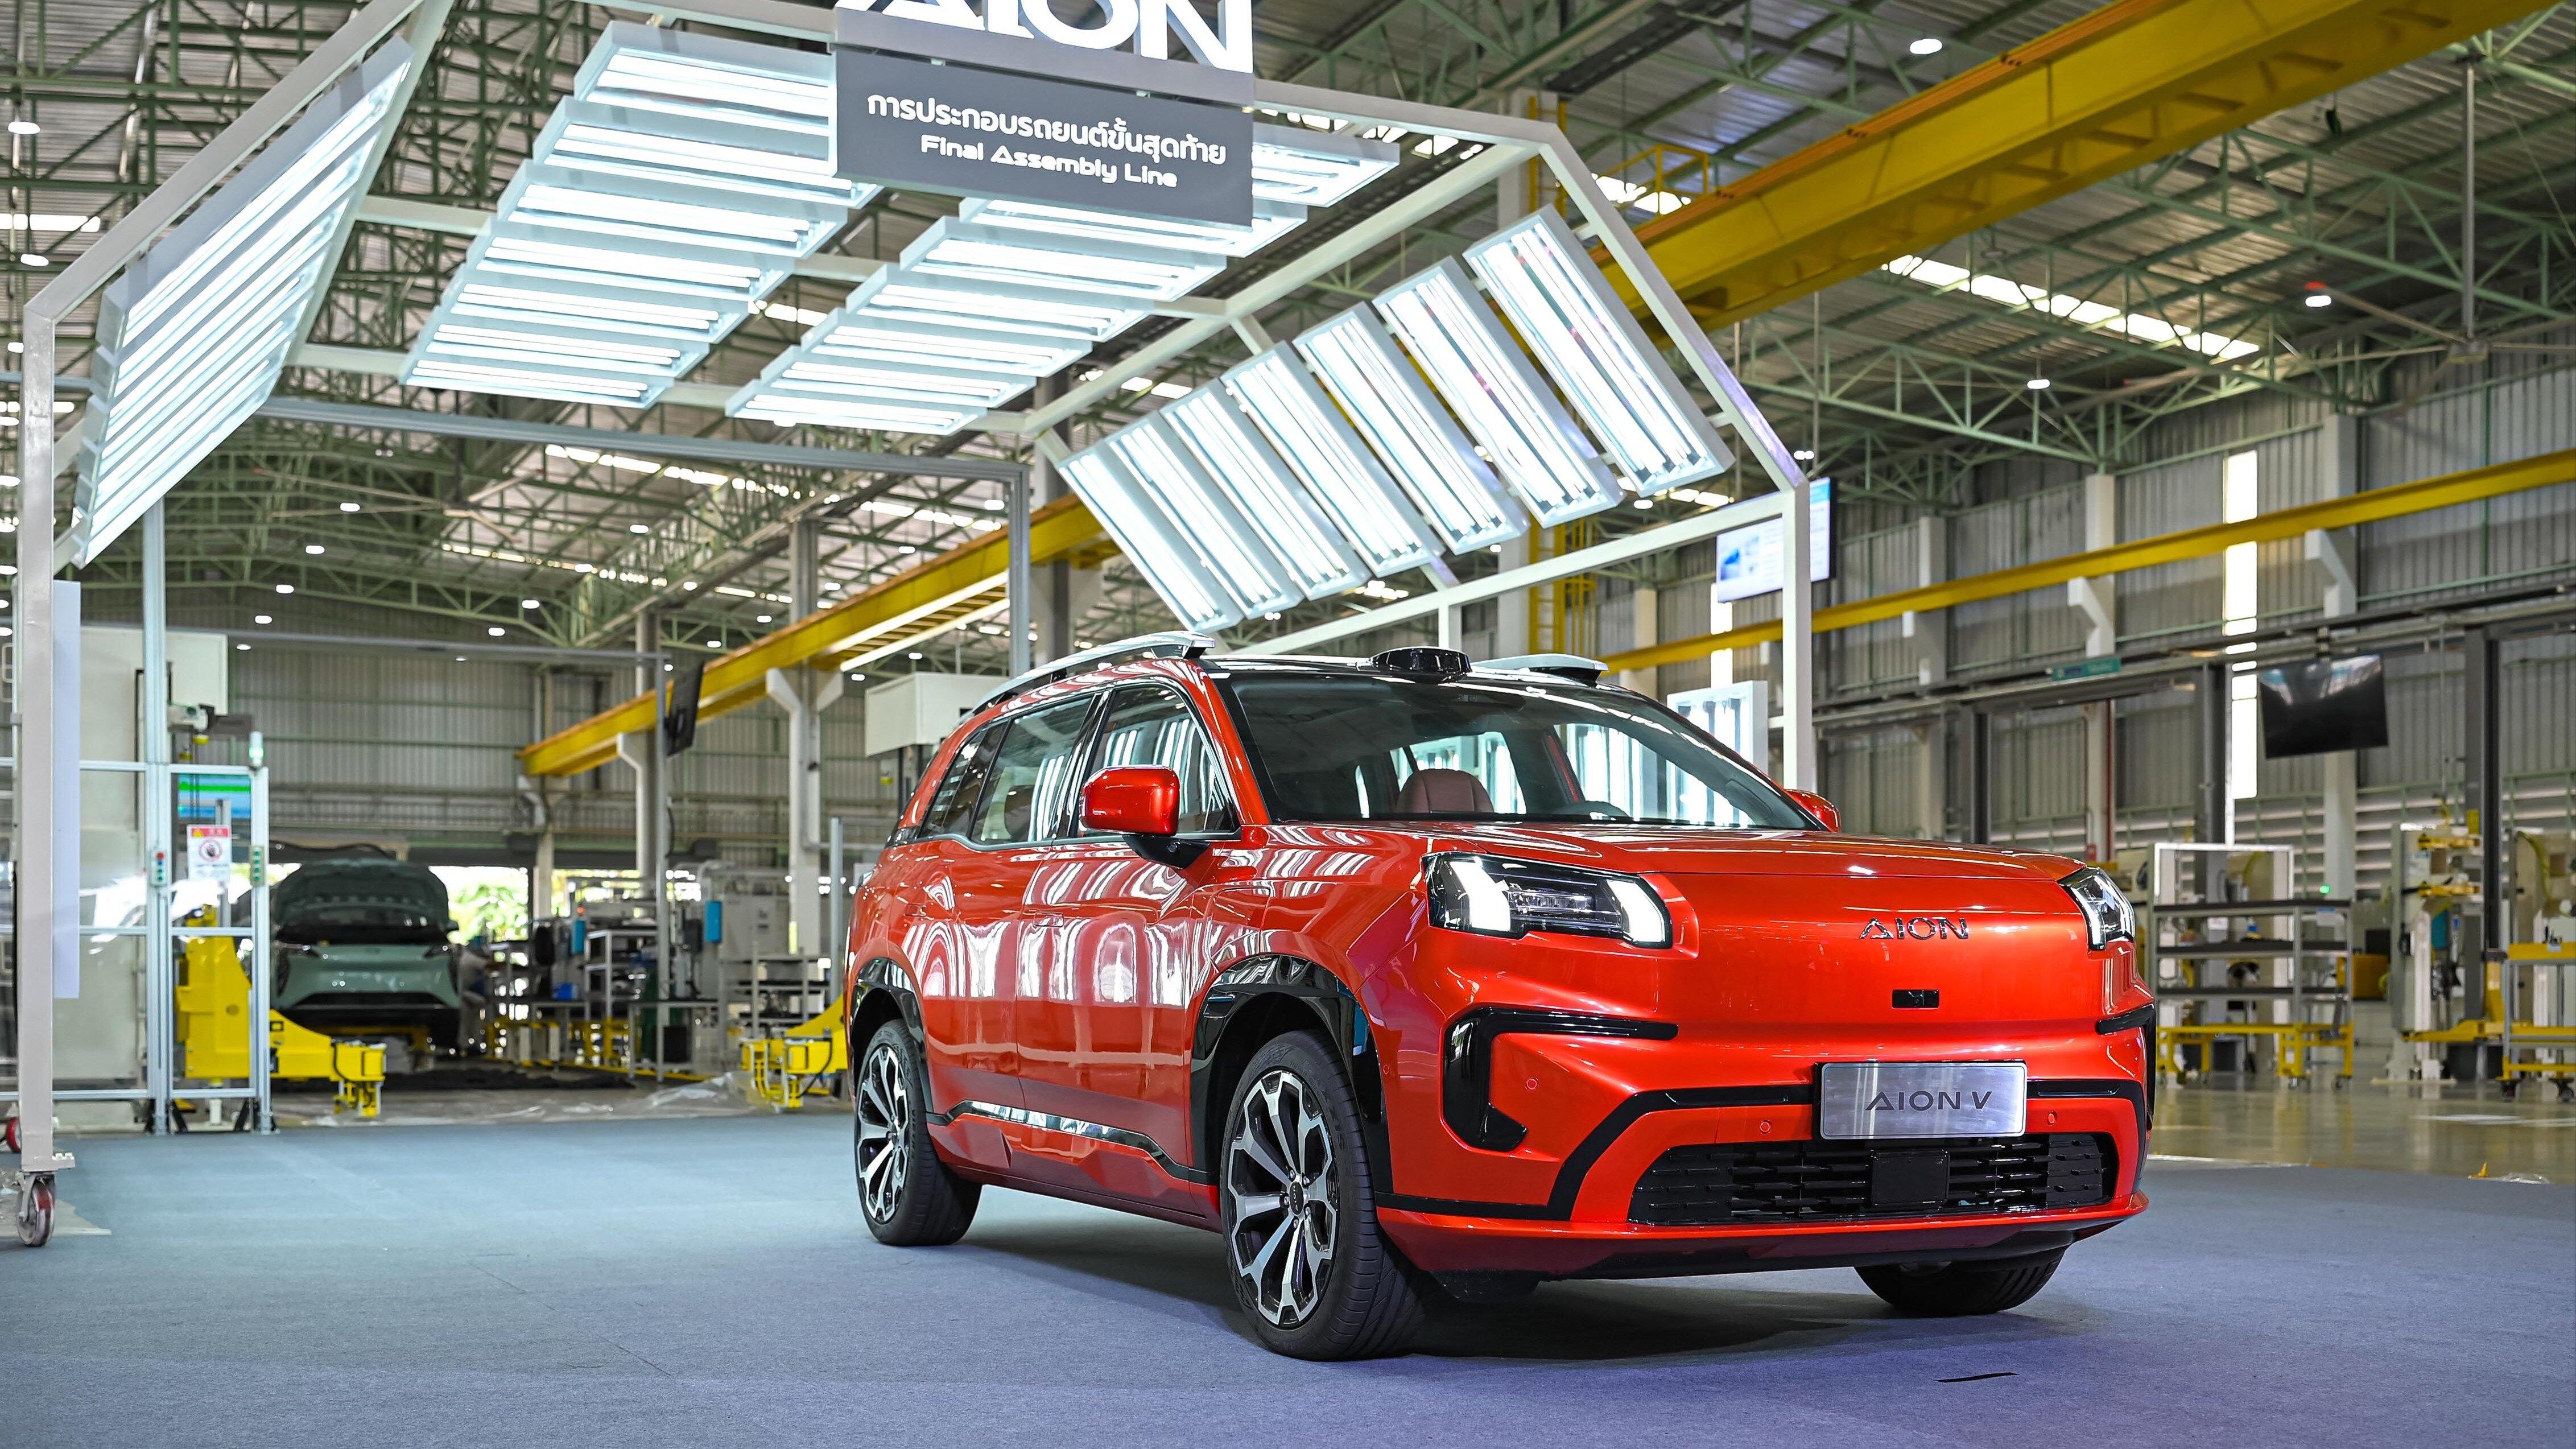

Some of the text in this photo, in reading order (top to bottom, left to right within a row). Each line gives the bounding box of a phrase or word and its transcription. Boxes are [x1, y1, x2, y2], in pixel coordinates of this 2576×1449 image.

[867, 94, 1227, 166] การประกอบรถยนต์ขั้นสุดท้าย
[921, 134, 1178, 188] Final Assembly Line
[1859, 917, 1969, 940] AION
[1865, 1091, 1992, 1112] AION V
